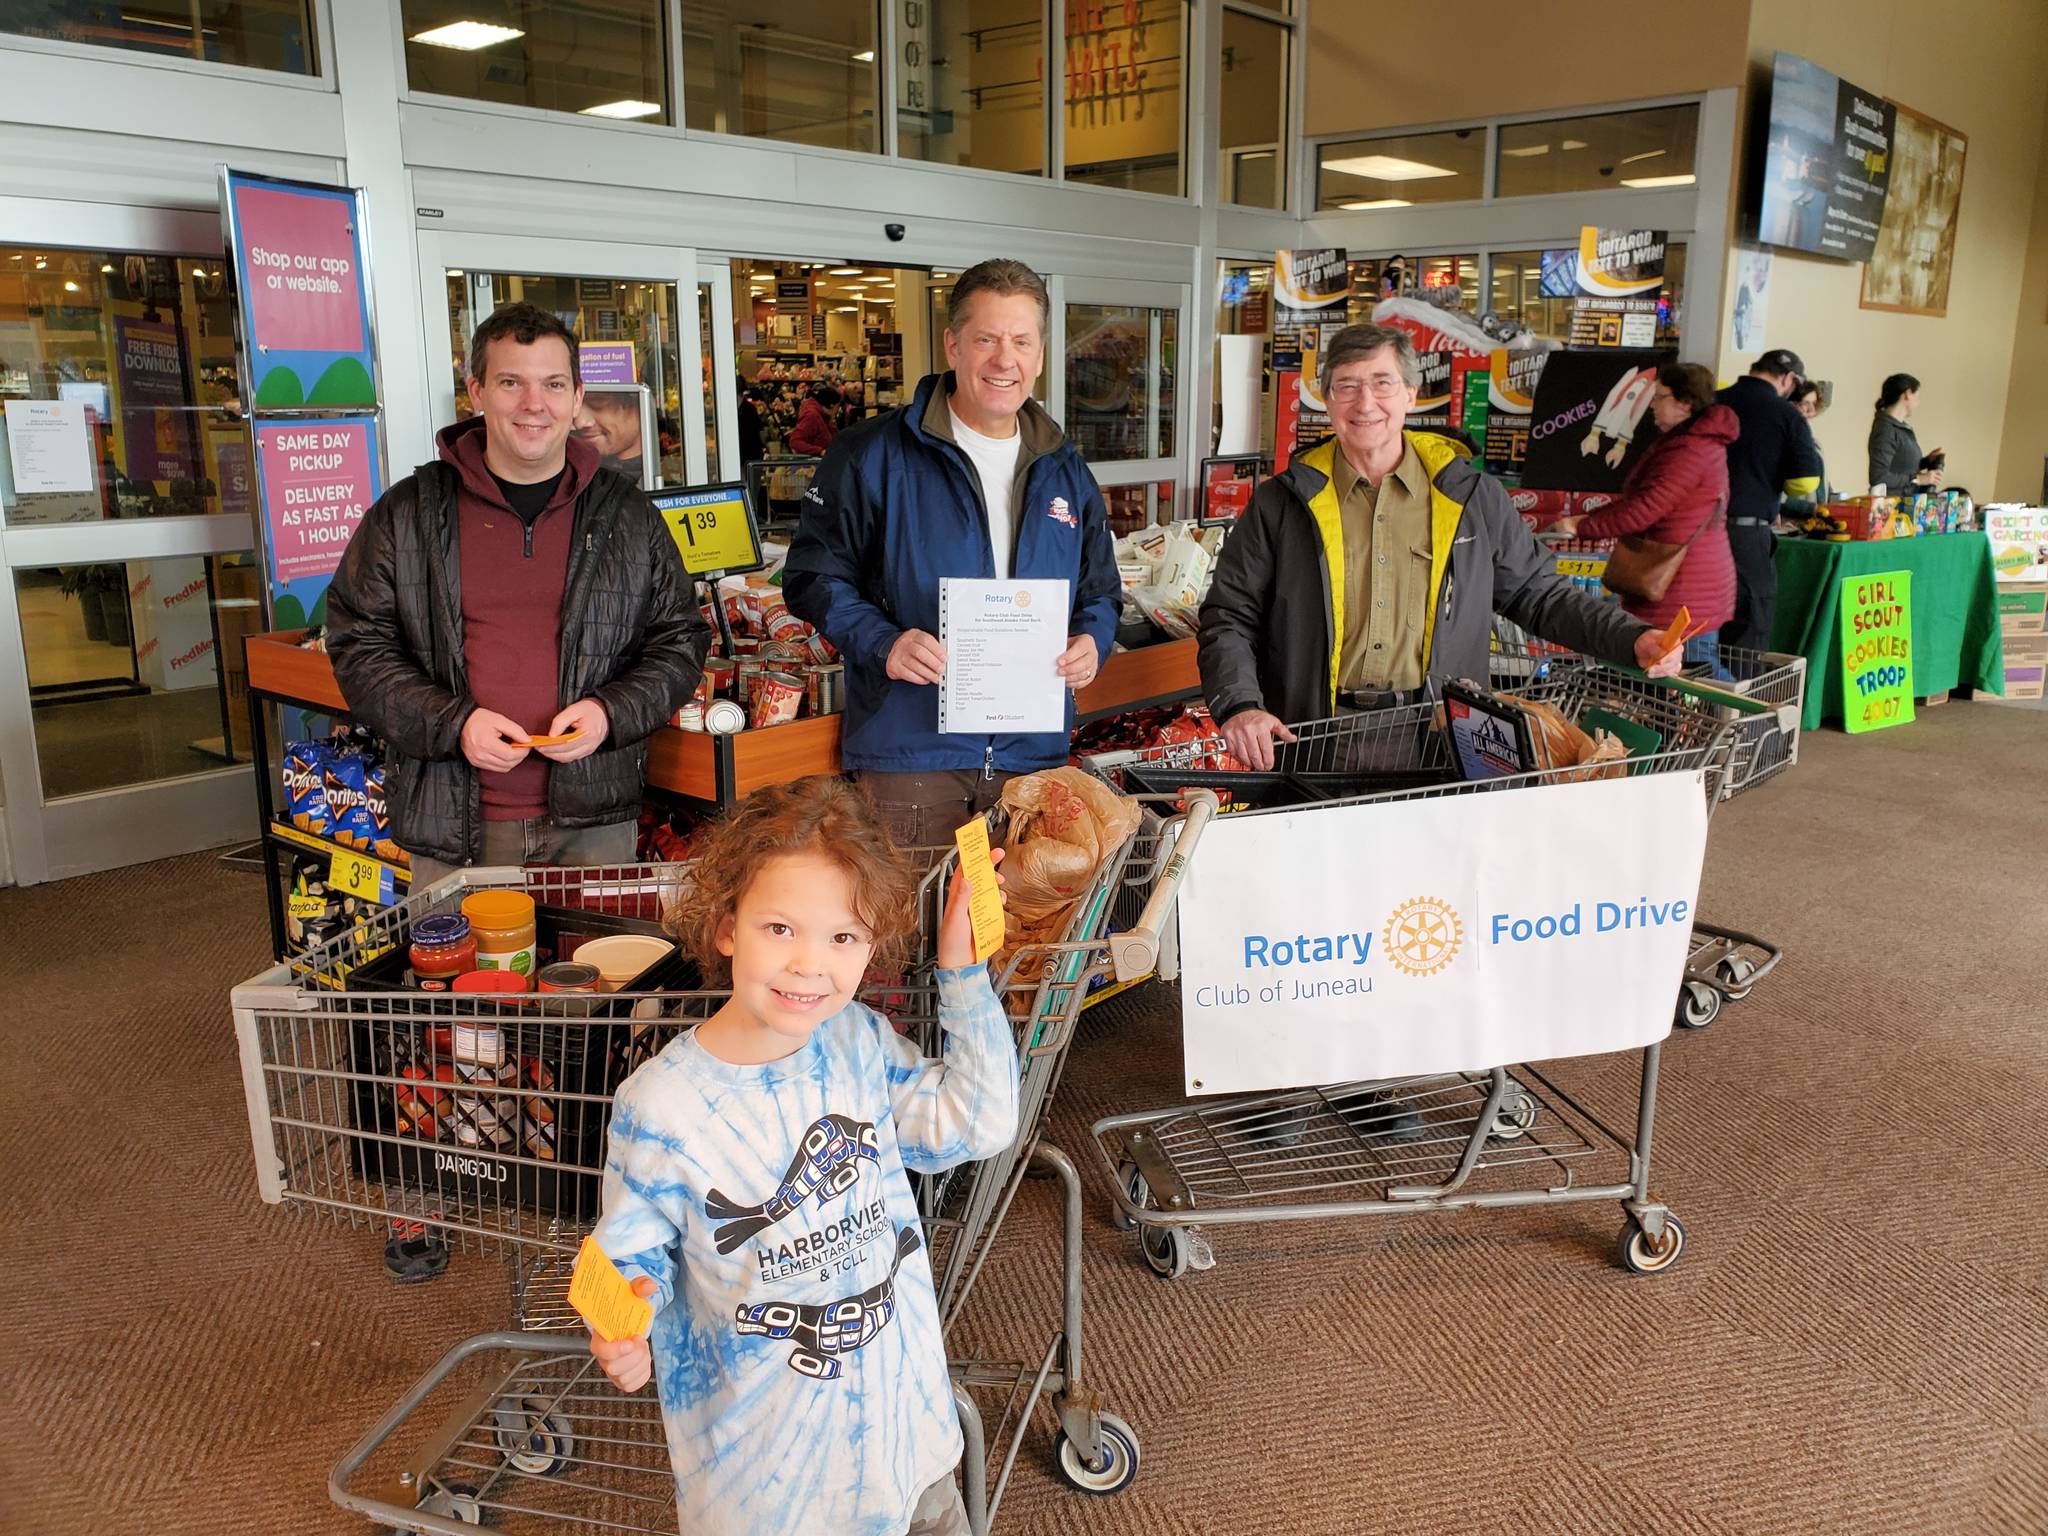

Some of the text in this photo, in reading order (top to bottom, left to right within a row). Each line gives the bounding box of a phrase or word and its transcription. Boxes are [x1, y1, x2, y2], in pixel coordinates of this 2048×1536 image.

[1598, 231, 1653, 257] IDITAROD
[1616, 252, 1631, 268] TO
[1633, 243, 1665, 265] WIN!
[252, 247, 349, 276] Shop our app
[1293, 249, 1337, 275] IDITAROD
[1309, 269, 1322, 284] TO
[1323, 259, 1346, 280] WIN!
[266, 274, 342, 293] or website.
[127, 339, 179, 359] FREE FRIDA
[124, 354, 181, 375] DOWNLOA
[1425, 363, 1450, 384] WIN!
[1508, 353, 1549, 376] IDITAR
[1532, 399, 1597, 440] COOKIES
[276, 433, 351, 451] SAME DAY
[289, 454, 343, 471] PICKUP
[284, 484, 354, 505] DELIVERY
[653, 499, 674, 508] RESH
[675, 497, 690, 506] FOR
[282, 504, 363, 526] AS FAST AS
[1991, 515, 2033, 529] GIFT
[298, 526, 350, 545] 1 HOUR
[678, 511, 717, 547] 1 39
[985, 593, 1013, 604] Rotary
[1857, 581, 1895, 605] GIRL
[1853, 605, 1903, 634] SCOUT
[1846, 636, 1908, 672] COOKIES
[1856, 665, 1906, 697] TROOP
[1862, 696, 1902, 724] 4007
[1473, 733, 1485, 751] ALL
[1485, 740, 1521, 769] AMERICAN
[324, 786, 368, 811] oritos
[349, 861, 360, 889] 3
[361, 864, 373, 880] 99
[1492, 896, 1688, 944] Food Drive
[1244, 931, 1373, 968] Rotary
[1195, 976, 1373, 1008] Club of Juneau
[434, 1152, 507, 1182] DARIGOLD
[762, 1215, 890, 1282] ELEMENTARY SCHOO
[820, 1250, 868, 1282] & TCLL
